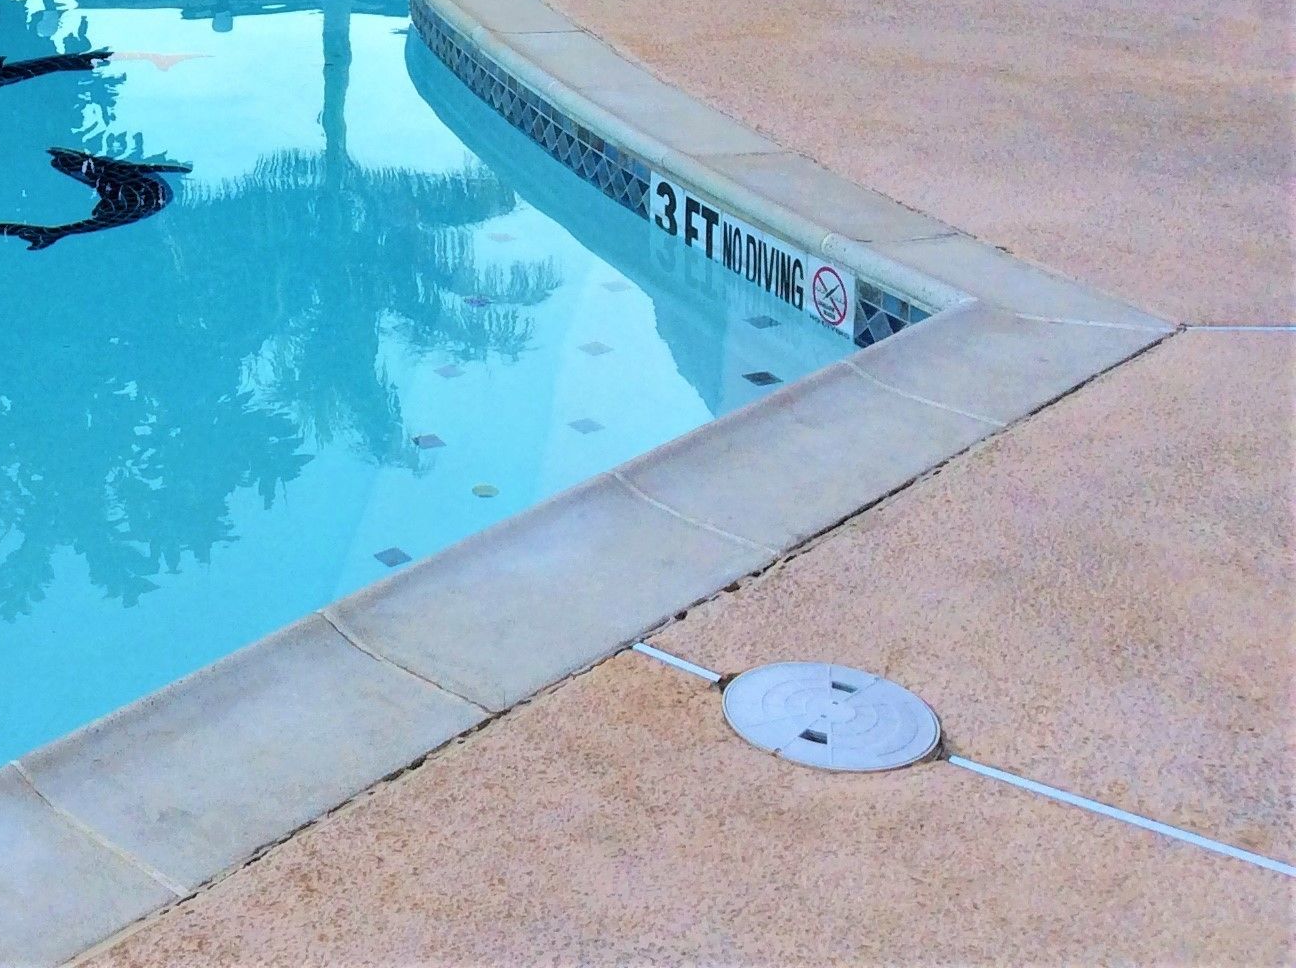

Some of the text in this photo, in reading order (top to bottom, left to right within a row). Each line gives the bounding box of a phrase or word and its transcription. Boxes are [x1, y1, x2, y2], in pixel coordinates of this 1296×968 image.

[655, 182, 804, 311] 3 FT NO DIVING
